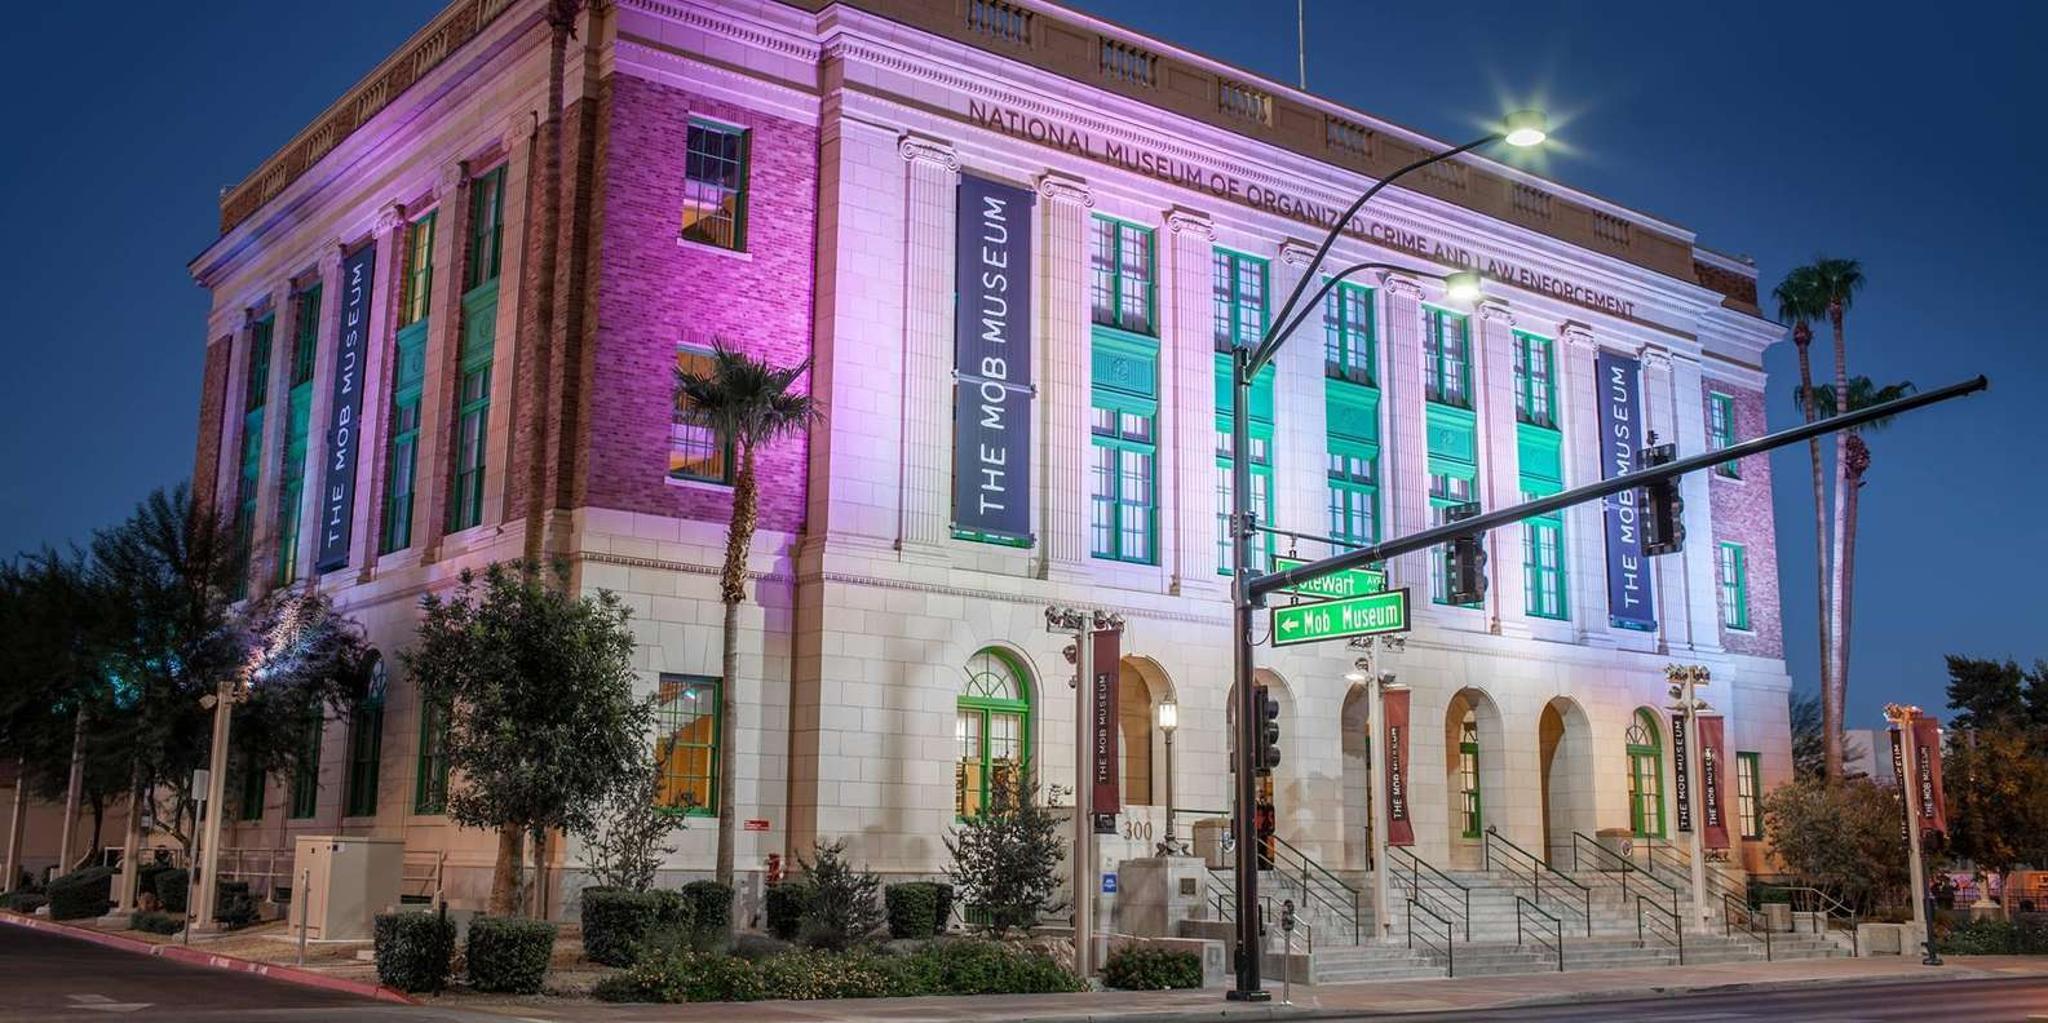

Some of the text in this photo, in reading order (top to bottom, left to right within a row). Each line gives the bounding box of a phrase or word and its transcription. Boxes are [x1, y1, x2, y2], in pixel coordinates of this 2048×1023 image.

[969, 99, 1098, 159] NATIONAL
[1105, 139, 1202, 189] MUSEUM
[1210, 174, 1239, 199] OF
[1369, 223, 1427, 252] CRIME
[1434, 240, 1472, 269] AND
[1520, 267, 1635, 318] ENFORCEMENT
[979, 195, 1008, 515] THE MOB MUSEUM
[328, 262, 363, 548] THE MOB MUSEUM
[1611, 366, 1640, 609] THE MOB MUSEUM
[1304, 603, 1398, 635] Mob Museum
[1099, 674, 1107, 782] THE MOB MUSEUM
[1675, 721, 1684, 771] MUSEUM
[1708, 786, 1716, 806] MOB
[1923, 782, 1932, 800] MOB
[1393, 798, 1402, 818] THE
[1680, 803, 1688, 827] THE
[1709, 807, 1717, 826] THE
[1124, 821, 1152, 840] 300
